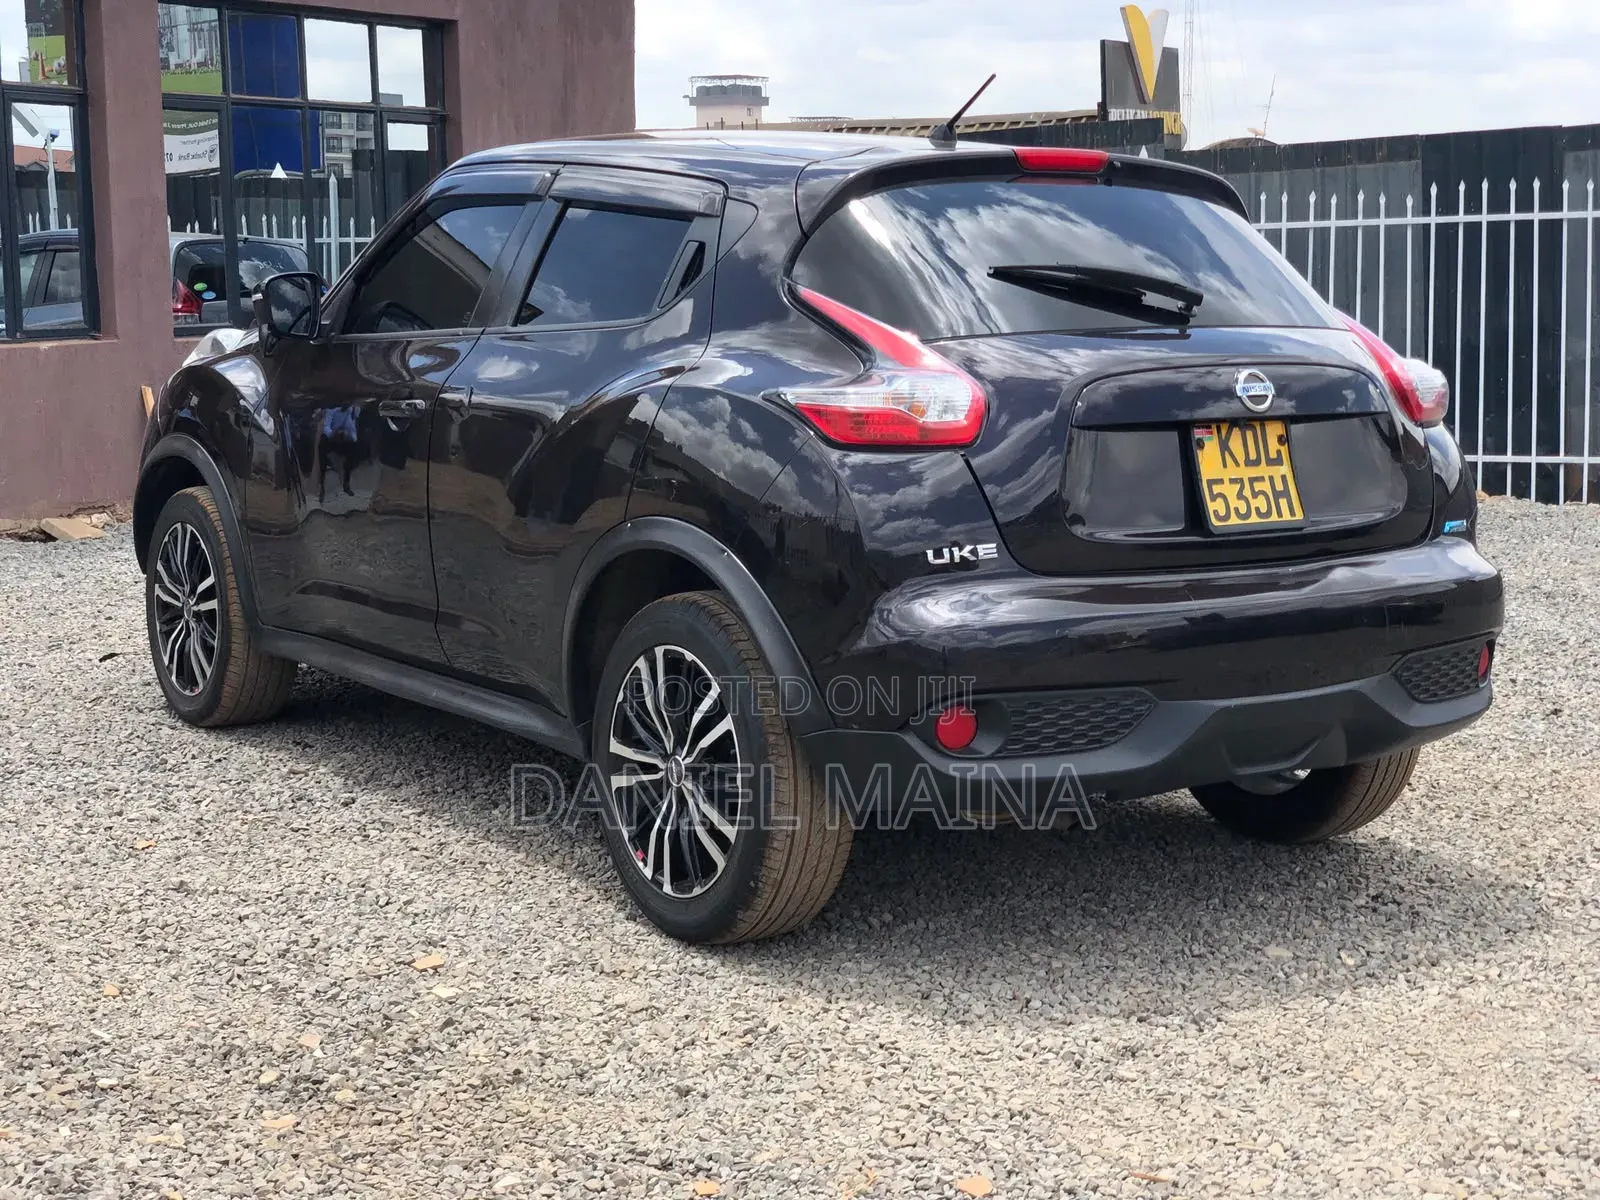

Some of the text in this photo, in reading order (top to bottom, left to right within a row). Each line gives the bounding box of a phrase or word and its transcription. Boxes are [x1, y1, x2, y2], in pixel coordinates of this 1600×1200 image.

[1241, 384, 1272, 394] NISSAN
[1216, 422, 1284, 469] KDL
[1206, 474, 1297, 523] 535H
[926, 543, 998, 565] UKE
